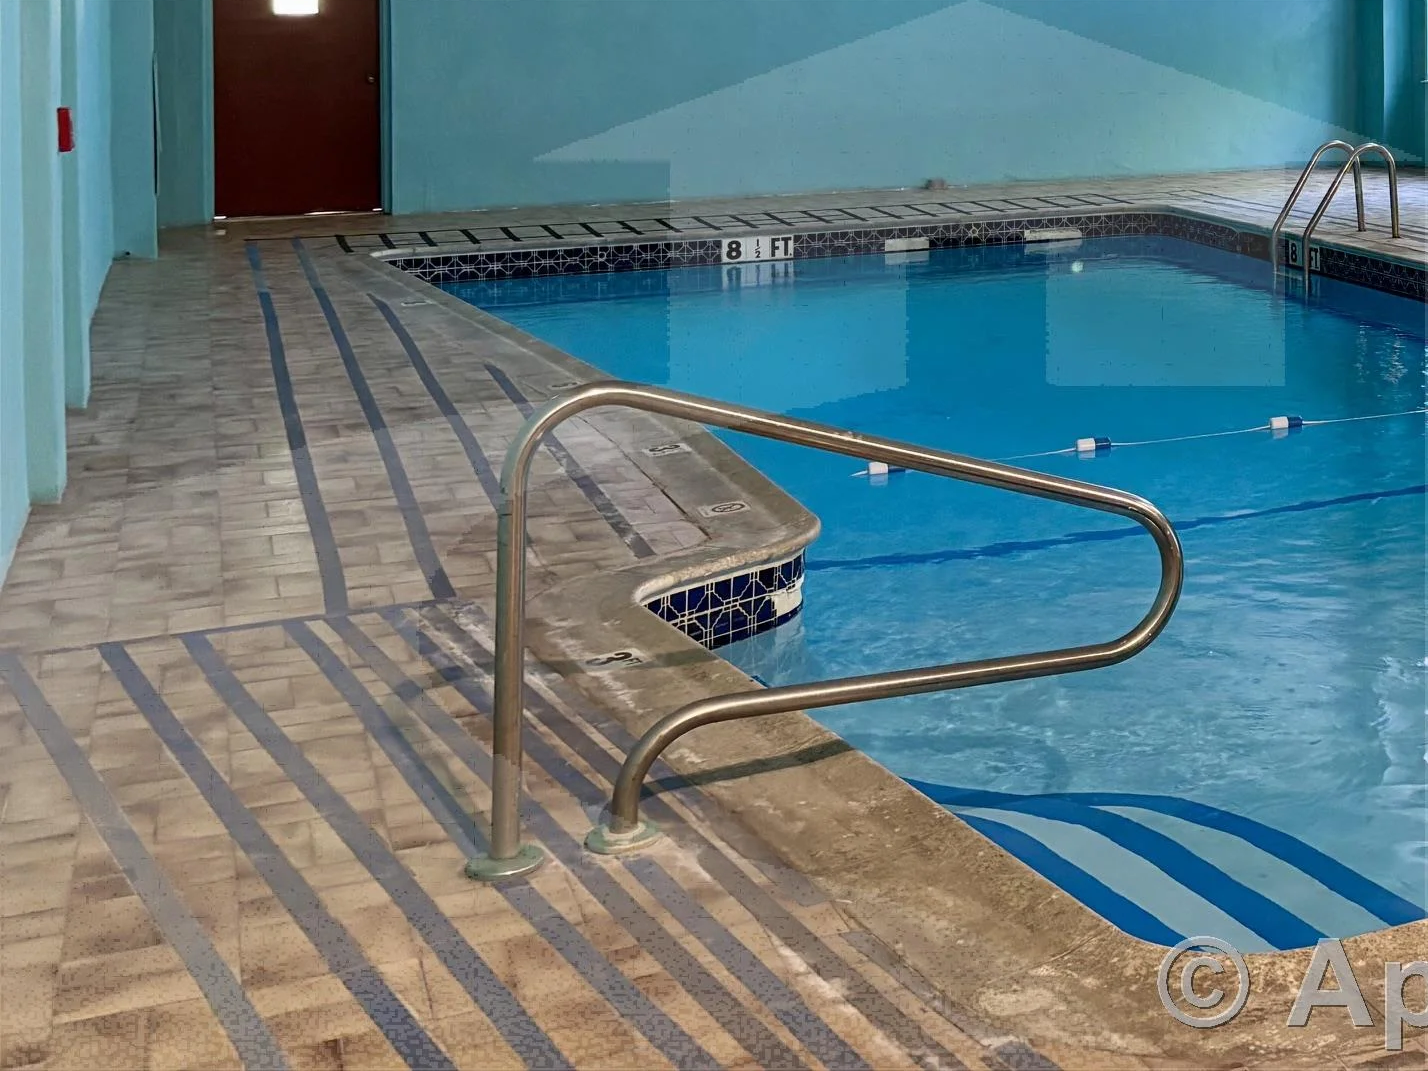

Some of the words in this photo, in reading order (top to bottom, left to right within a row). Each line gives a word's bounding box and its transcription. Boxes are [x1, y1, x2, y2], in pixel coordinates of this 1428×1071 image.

[726, 240, 742, 260] 8
[771, 236, 793, 257] FT.
[1290, 242, 1298, 263] 8
[585, 652, 632, 666] 3
